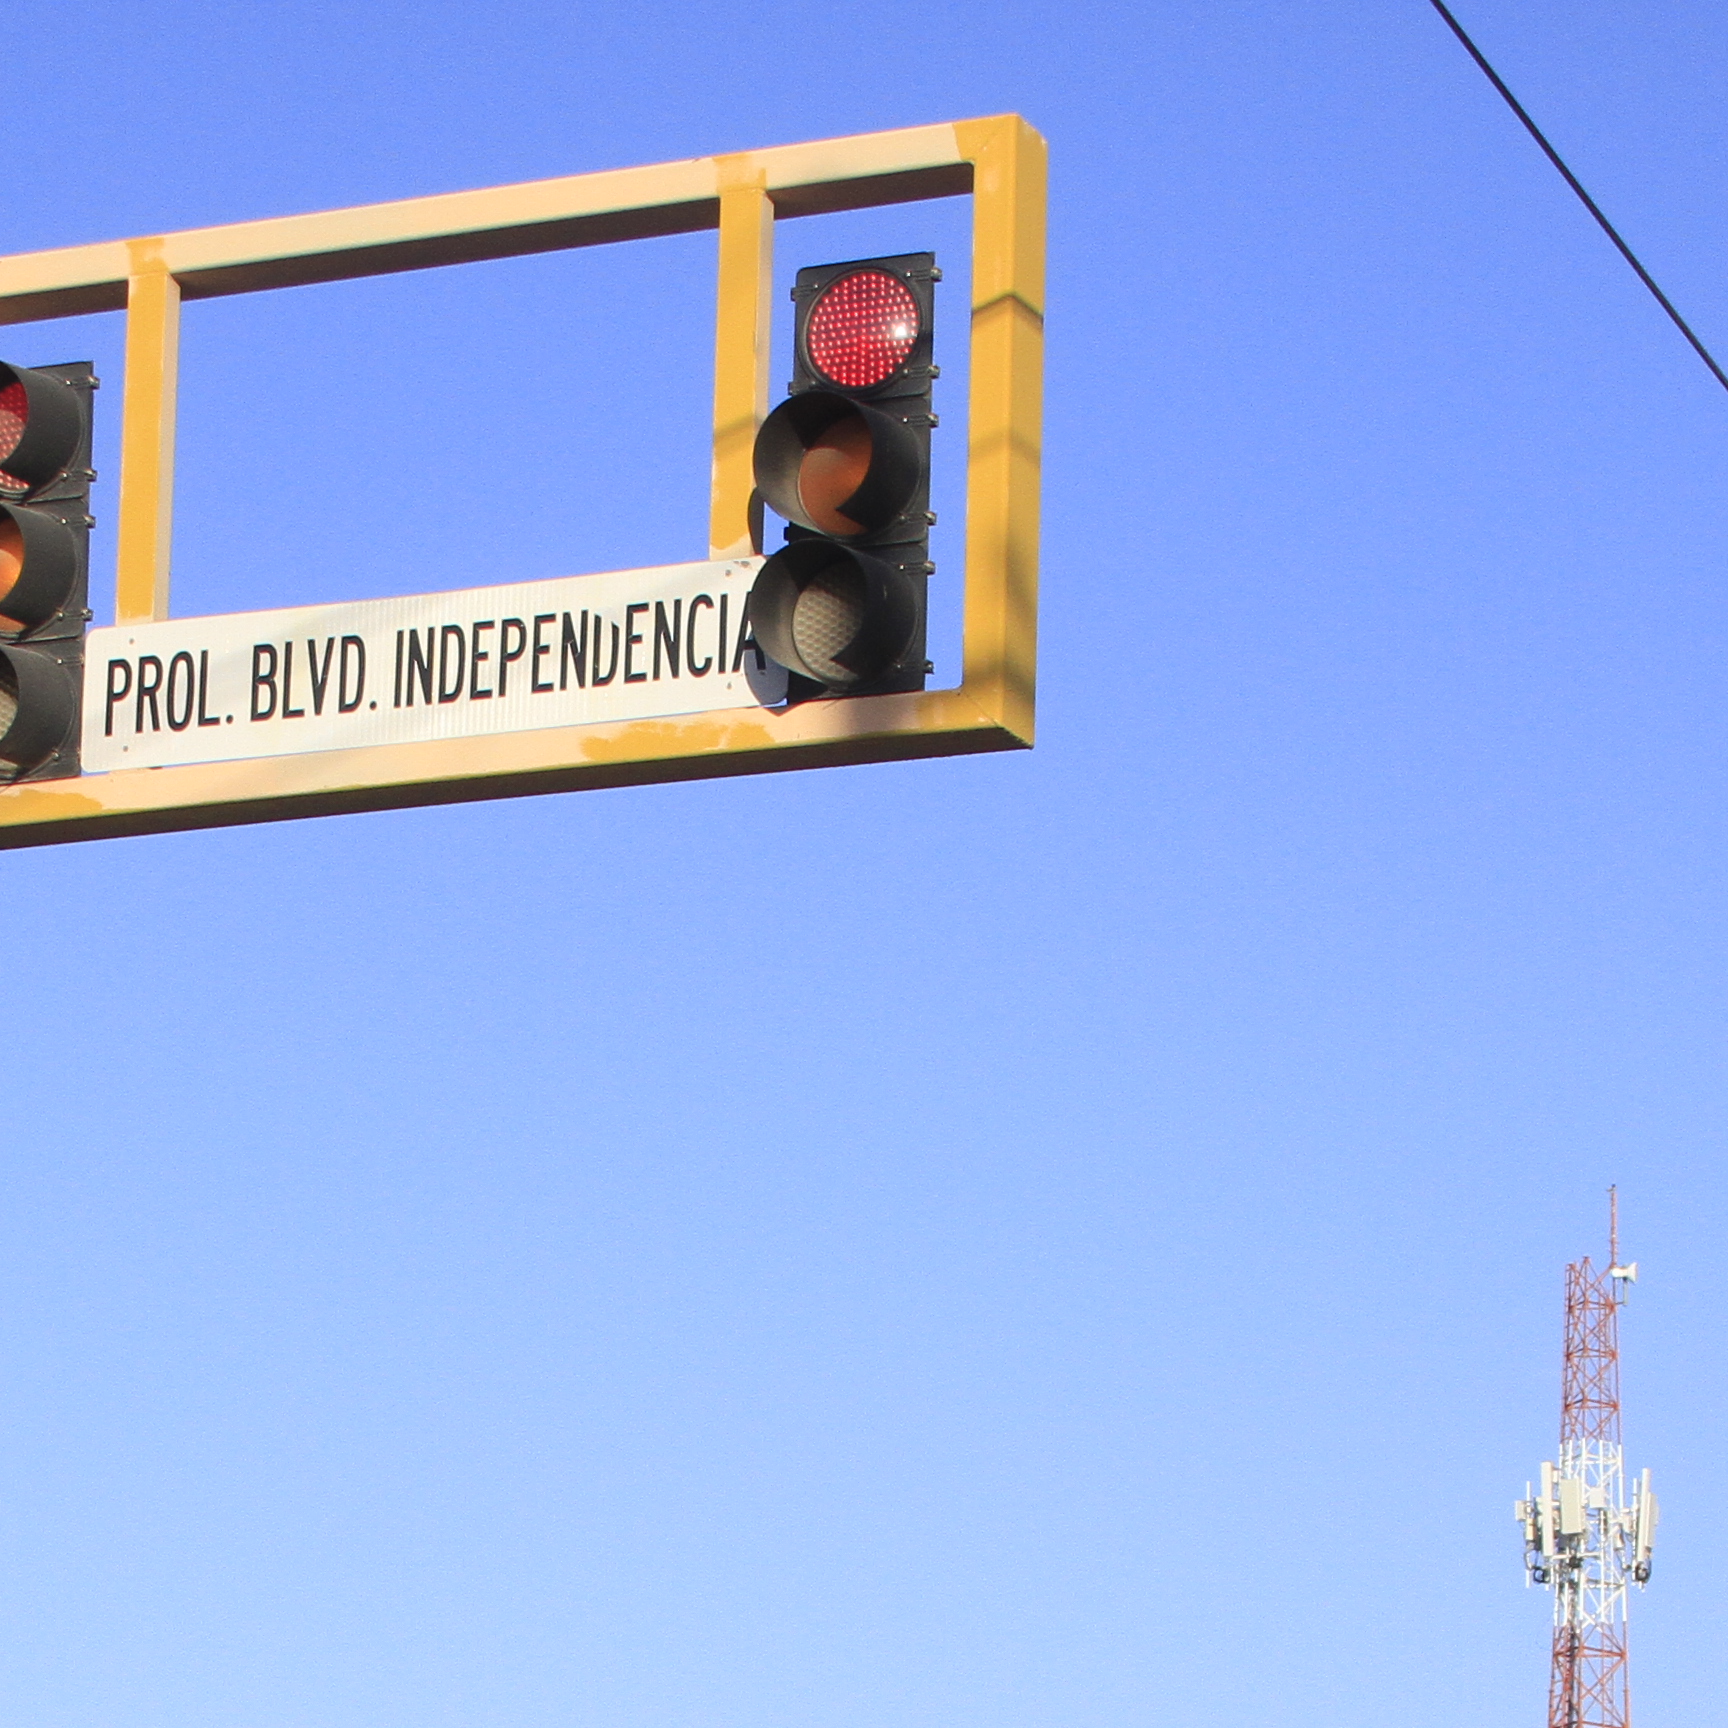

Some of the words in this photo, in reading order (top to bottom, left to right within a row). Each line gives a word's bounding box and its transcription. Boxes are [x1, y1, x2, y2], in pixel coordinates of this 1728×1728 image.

[103, 650, 233, 738] PROL.
[251, 626, 378, 724] BLVD.
[393, 589, 766, 705] INDEPENDENCIA
